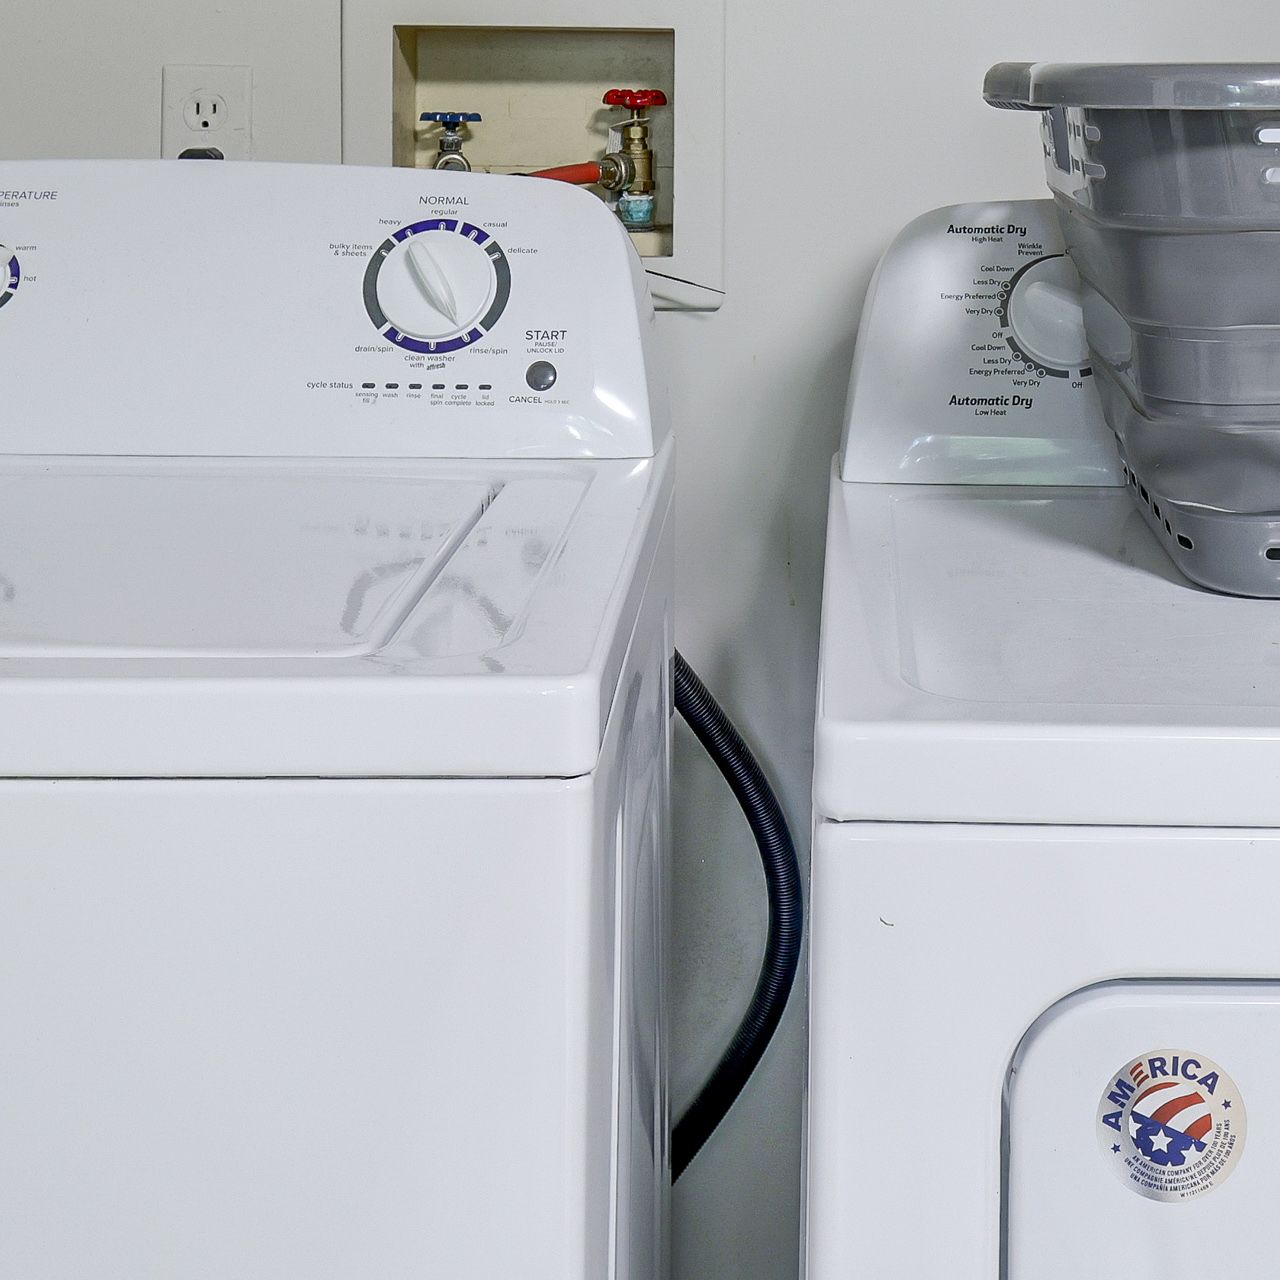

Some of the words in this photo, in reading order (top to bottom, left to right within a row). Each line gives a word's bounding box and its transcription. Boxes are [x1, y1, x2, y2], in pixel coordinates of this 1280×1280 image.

[419, 196, 469, 206] NORMAL
[431, 208, 458, 216] regular
[379, 218, 402, 226] heavy
[947, 224, 1005, 234] Automatic
[1006, 224, 1027, 237] Dry
[329, 243, 351, 251] bulky
[507, 246, 538, 254] delicate
[989, 279, 1001, 287] Dry
[940, 293, 963, 301] Energy
[525, 330, 567, 340] START
[354, 345, 394, 354] drain/spin
[469, 347, 508, 355] rinse/spin
[969, 368, 992, 376] Energy
[306, 381, 328, 389] cycle
[1028, 379, 1040, 387] Dry
[508, 395, 542, 404] CANCEL
[949, 395, 1010, 406] Automatic
[1011, 395, 1033, 409] Dry
[1102, 1056, 1220, 1133] AMERICA
[1139, 1160, 1165, 1175] AMERICAN
[1167, 1166, 1192, 1176] COMPANY
[1192, 1161, 1203, 1170] FOR
[1202, 1149, 1214, 1162] OVER
[1214, 1122, 1222, 1140] YEARS
[1197, 1161, 1215, 1176] DEPUIS
[1213, 1148, 1223, 1162] PLUS
[1220, 1140, 1227, 1149] DE
[1130, 1172, 1141, 1183] UNA
[1170, 1180, 1200, 1191] AMERICANA
[1200, 1174, 1211, 1185] POR
[1219, 1158, 1227, 1166] DE
[1223, 1149, 1231, 1159] 100
